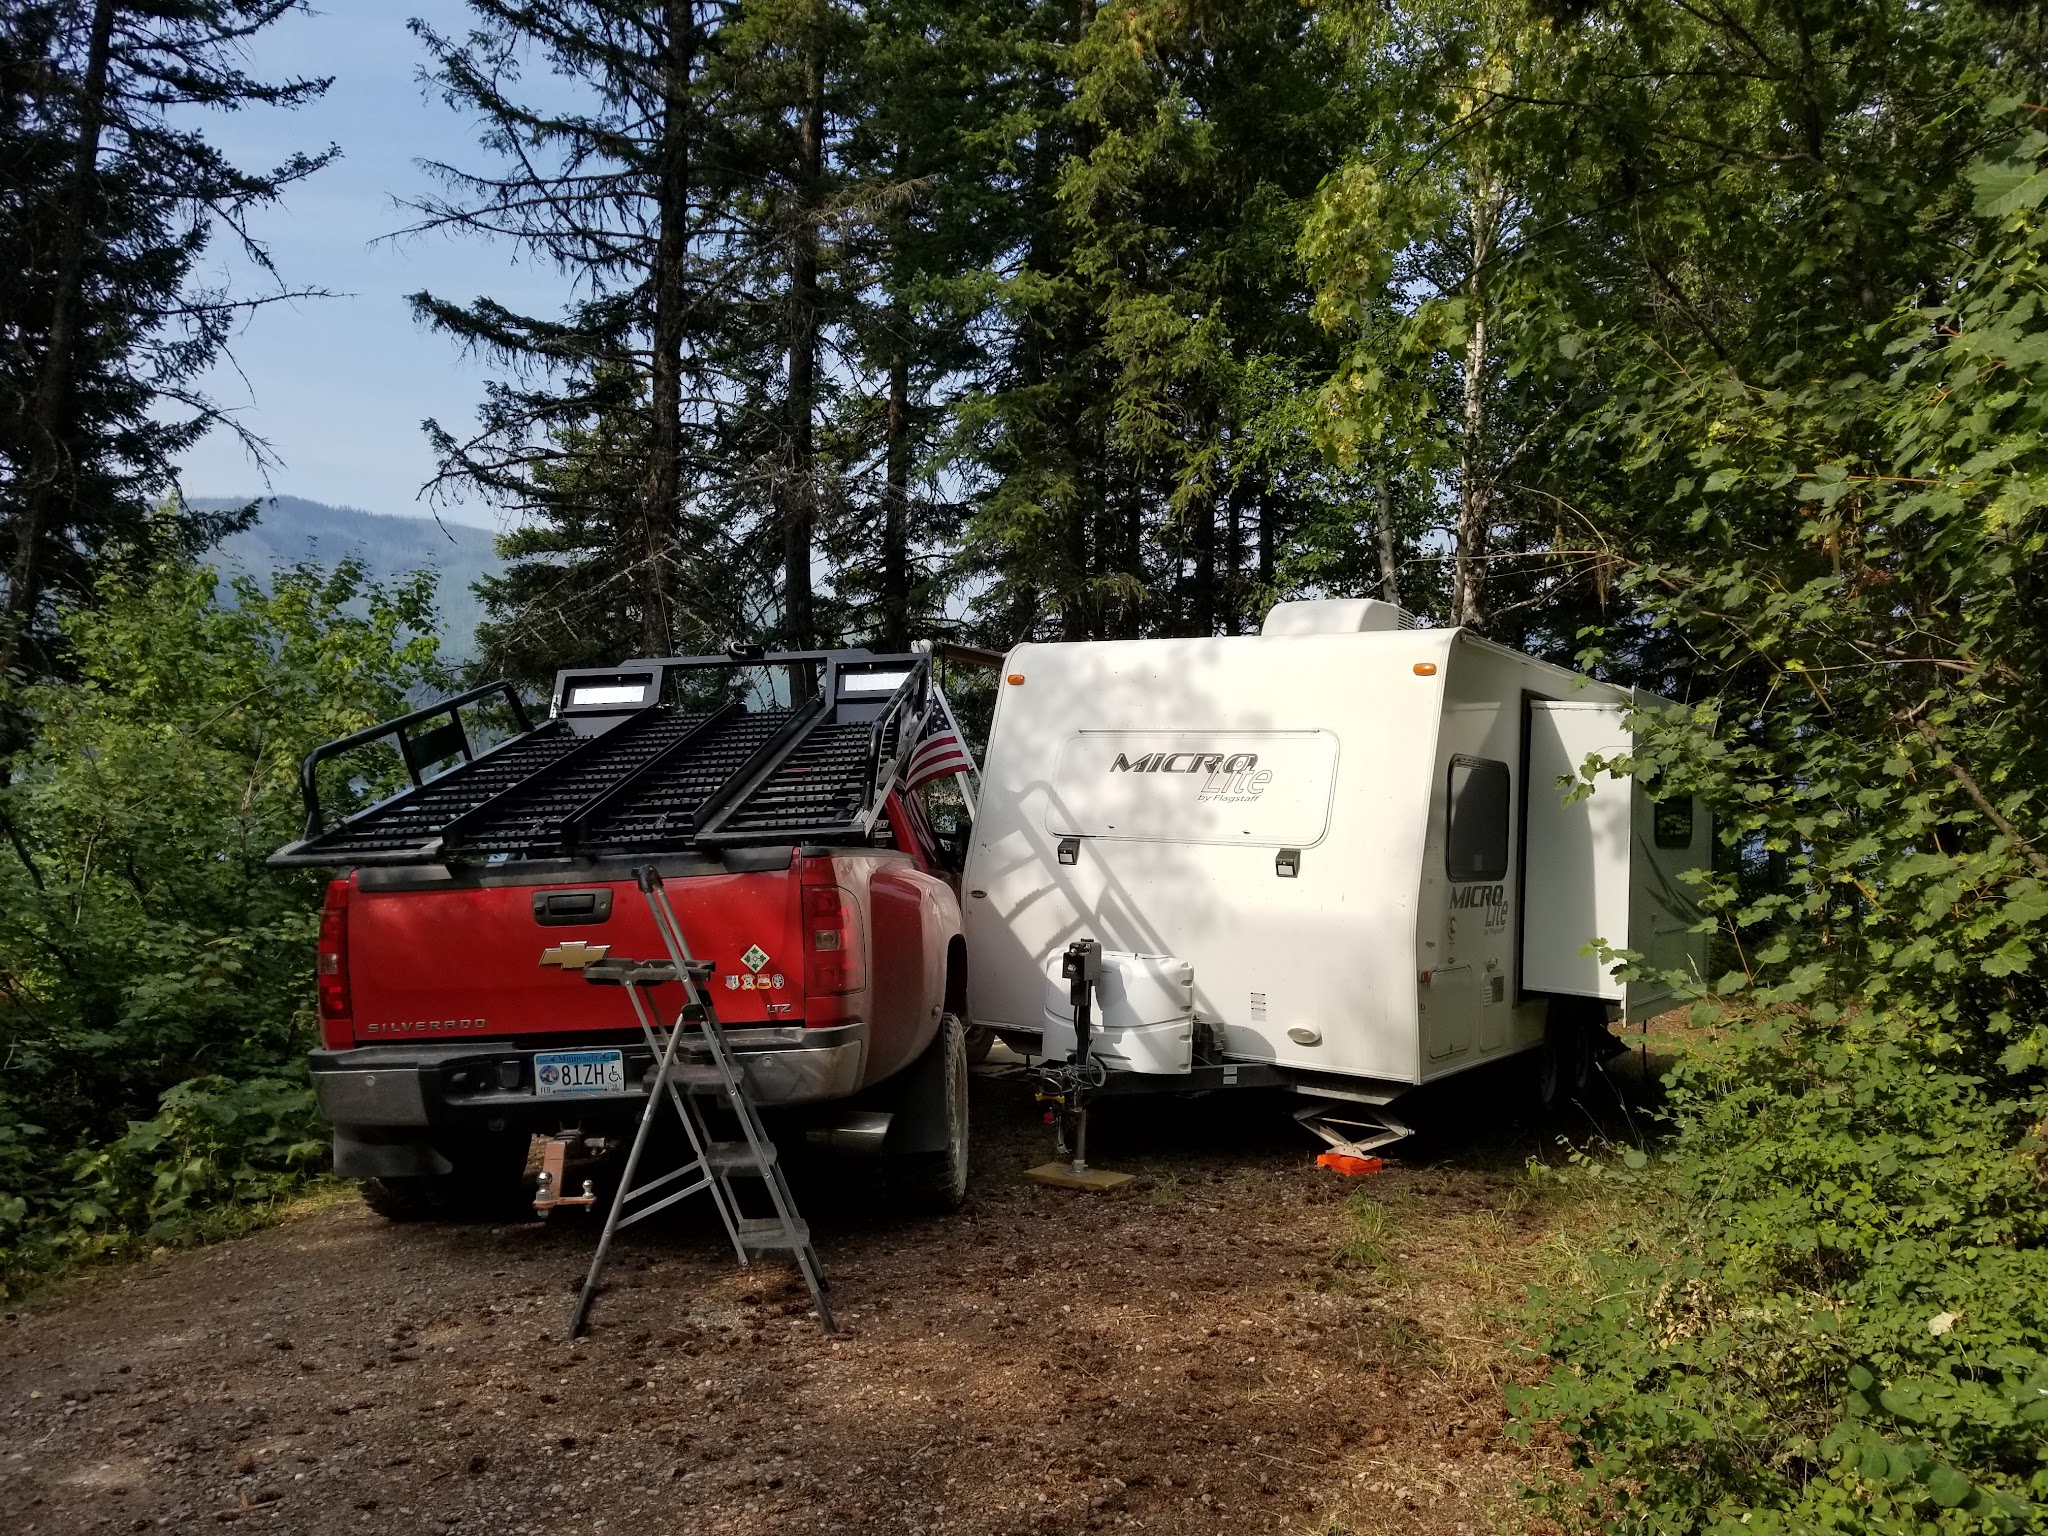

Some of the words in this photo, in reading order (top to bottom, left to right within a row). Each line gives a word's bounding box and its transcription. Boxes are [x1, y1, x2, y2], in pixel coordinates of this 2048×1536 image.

[1109, 752, 1258, 774] MICRO
[1200, 761, 1273, 795] Lite
[1197, 794, 1211, 803] by
[1213, 794, 1260, 803] Flagstaff
[1450, 885, 1503, 909] MICRO
[766, 1003, 791, 1013] LTZ
[368, 1019, 486, 1033] SILVERADO
[558, 1053, 598, 1062] Minnesota
[561, 1063, 605, 1086] 81ZH
